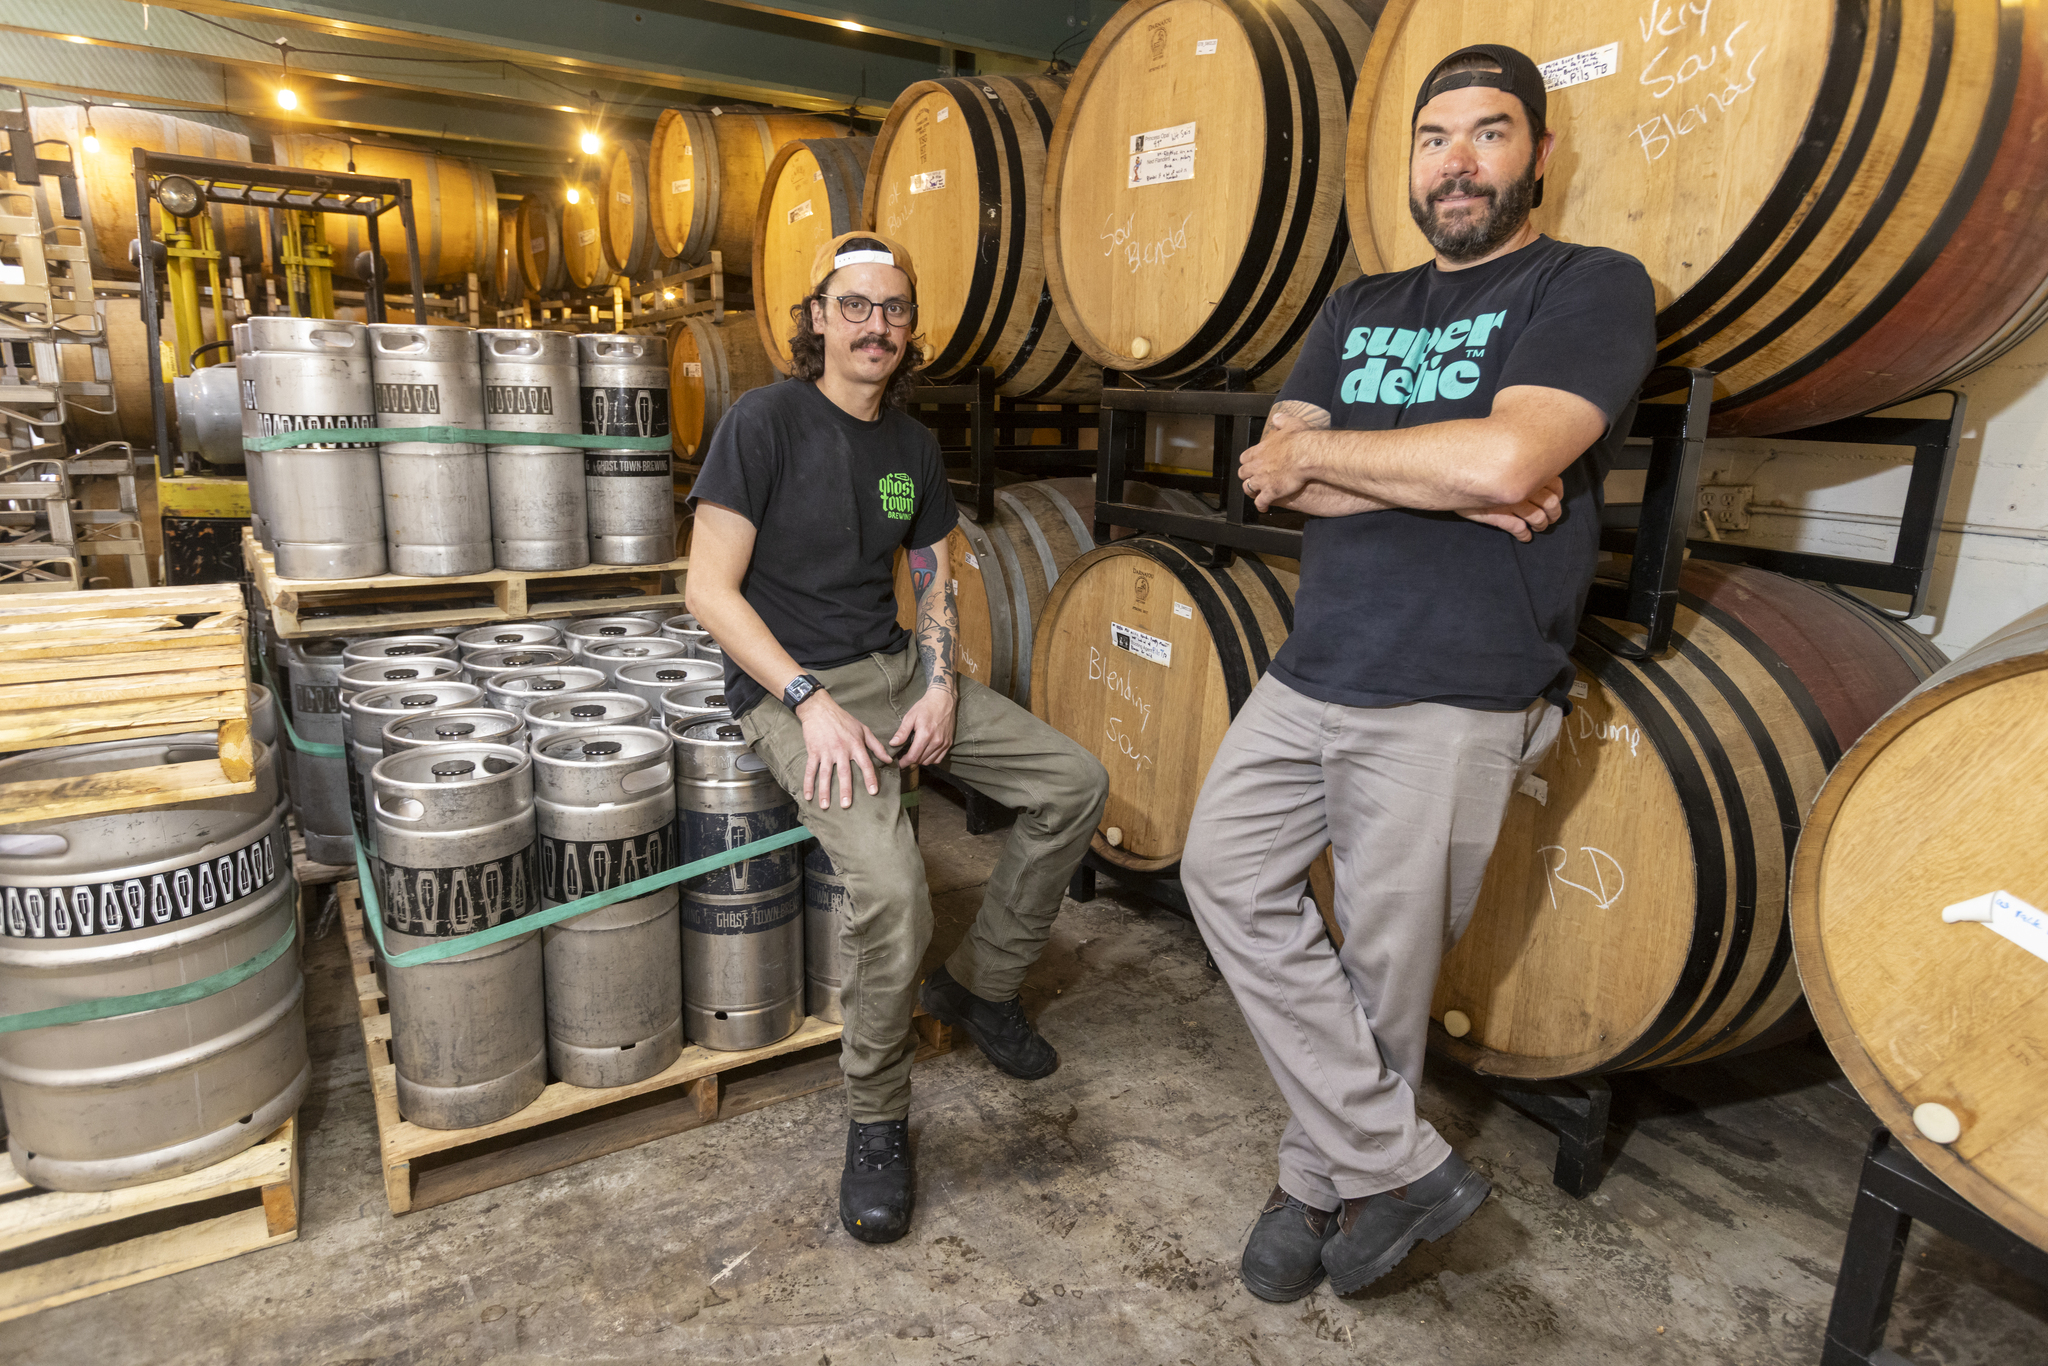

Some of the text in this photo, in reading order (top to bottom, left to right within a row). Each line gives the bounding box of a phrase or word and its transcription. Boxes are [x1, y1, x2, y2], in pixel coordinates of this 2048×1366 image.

[1639, 21, 1750, 99] Sour
[1100, 211, 1136, 257] Sour
[1342, 309, 1507, 373] super
[1341, 354, 1480, 409] delic
[597, 460, 617, 472] GHOST
[619, 460, 642, 472] TOWN
[642, 460, 668, 472] BREWING
[879, 473, 915, 499] ghost
[880, 495, 914, 514] town
[959, 644, 978, 674] nder
[1089, 646, 1151, 732] Blending
[1106, 717, 1152, 771] Sour
[1578, 705, 1640, 758] Dump
[716, 912, 748, 928] GHOST
[752, 905, 779, 925] TOWN
